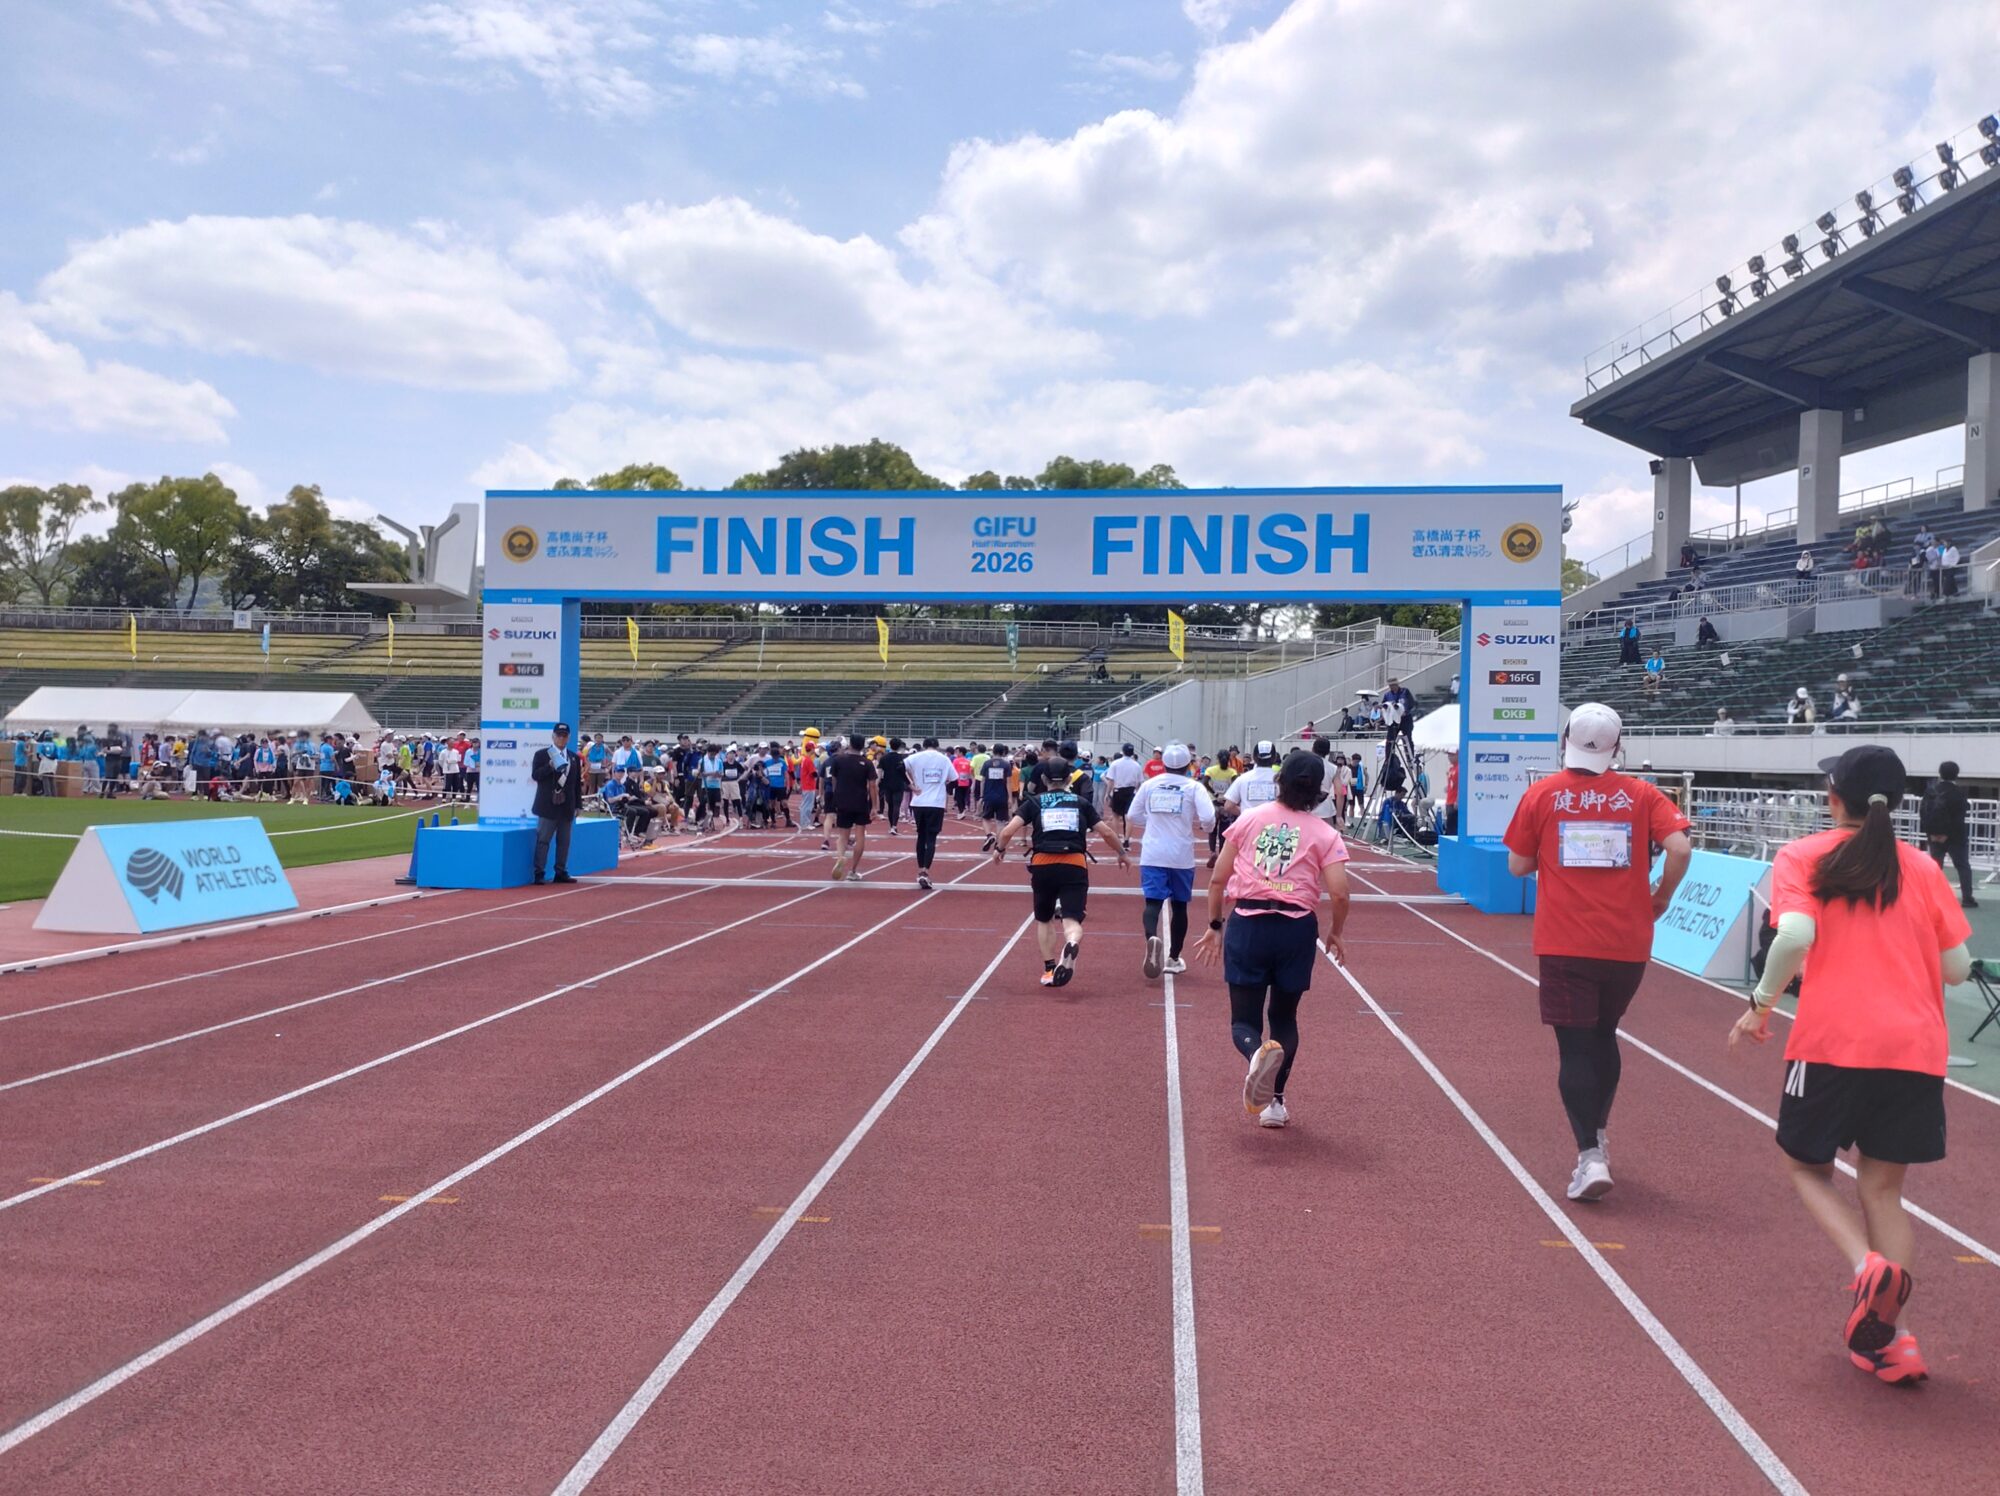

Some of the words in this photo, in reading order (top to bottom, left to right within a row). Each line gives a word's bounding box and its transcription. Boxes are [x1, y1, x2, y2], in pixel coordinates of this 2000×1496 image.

[1970, 425, 1980, 438] N
[1802, 467, 1810, 478] P
[973, 516, 1036, 537] GIFU
[546, 530, 609, 544] 高橋尚子杯
[1412, 529, 1481, 542] 高橋尚子杯
[656, 516, 916, 577] FINISH
[1092, 513, 1370, 576] FINISH
[971, 551, 1034, 573] 2026
[503, 630, 557, 640] SUZUKI
[1494, 635, 1555, 645] SUZUKI
[516, 666, 539, 675] 16FG
[1509, 673, 1535, 682] 16FG
[509, 699, 532, 708] OKB
[1501, 710, 1527, 719] OKB
[1551, 788, 1634, 813] 健脚会
[181, 845, 241, 869] WORLD
[195, 865, 277, 893] ATHLETICS
[1678, 880, 1722, 907] WORLD
[1662, 905, 1725, 940] ATHLETICS
